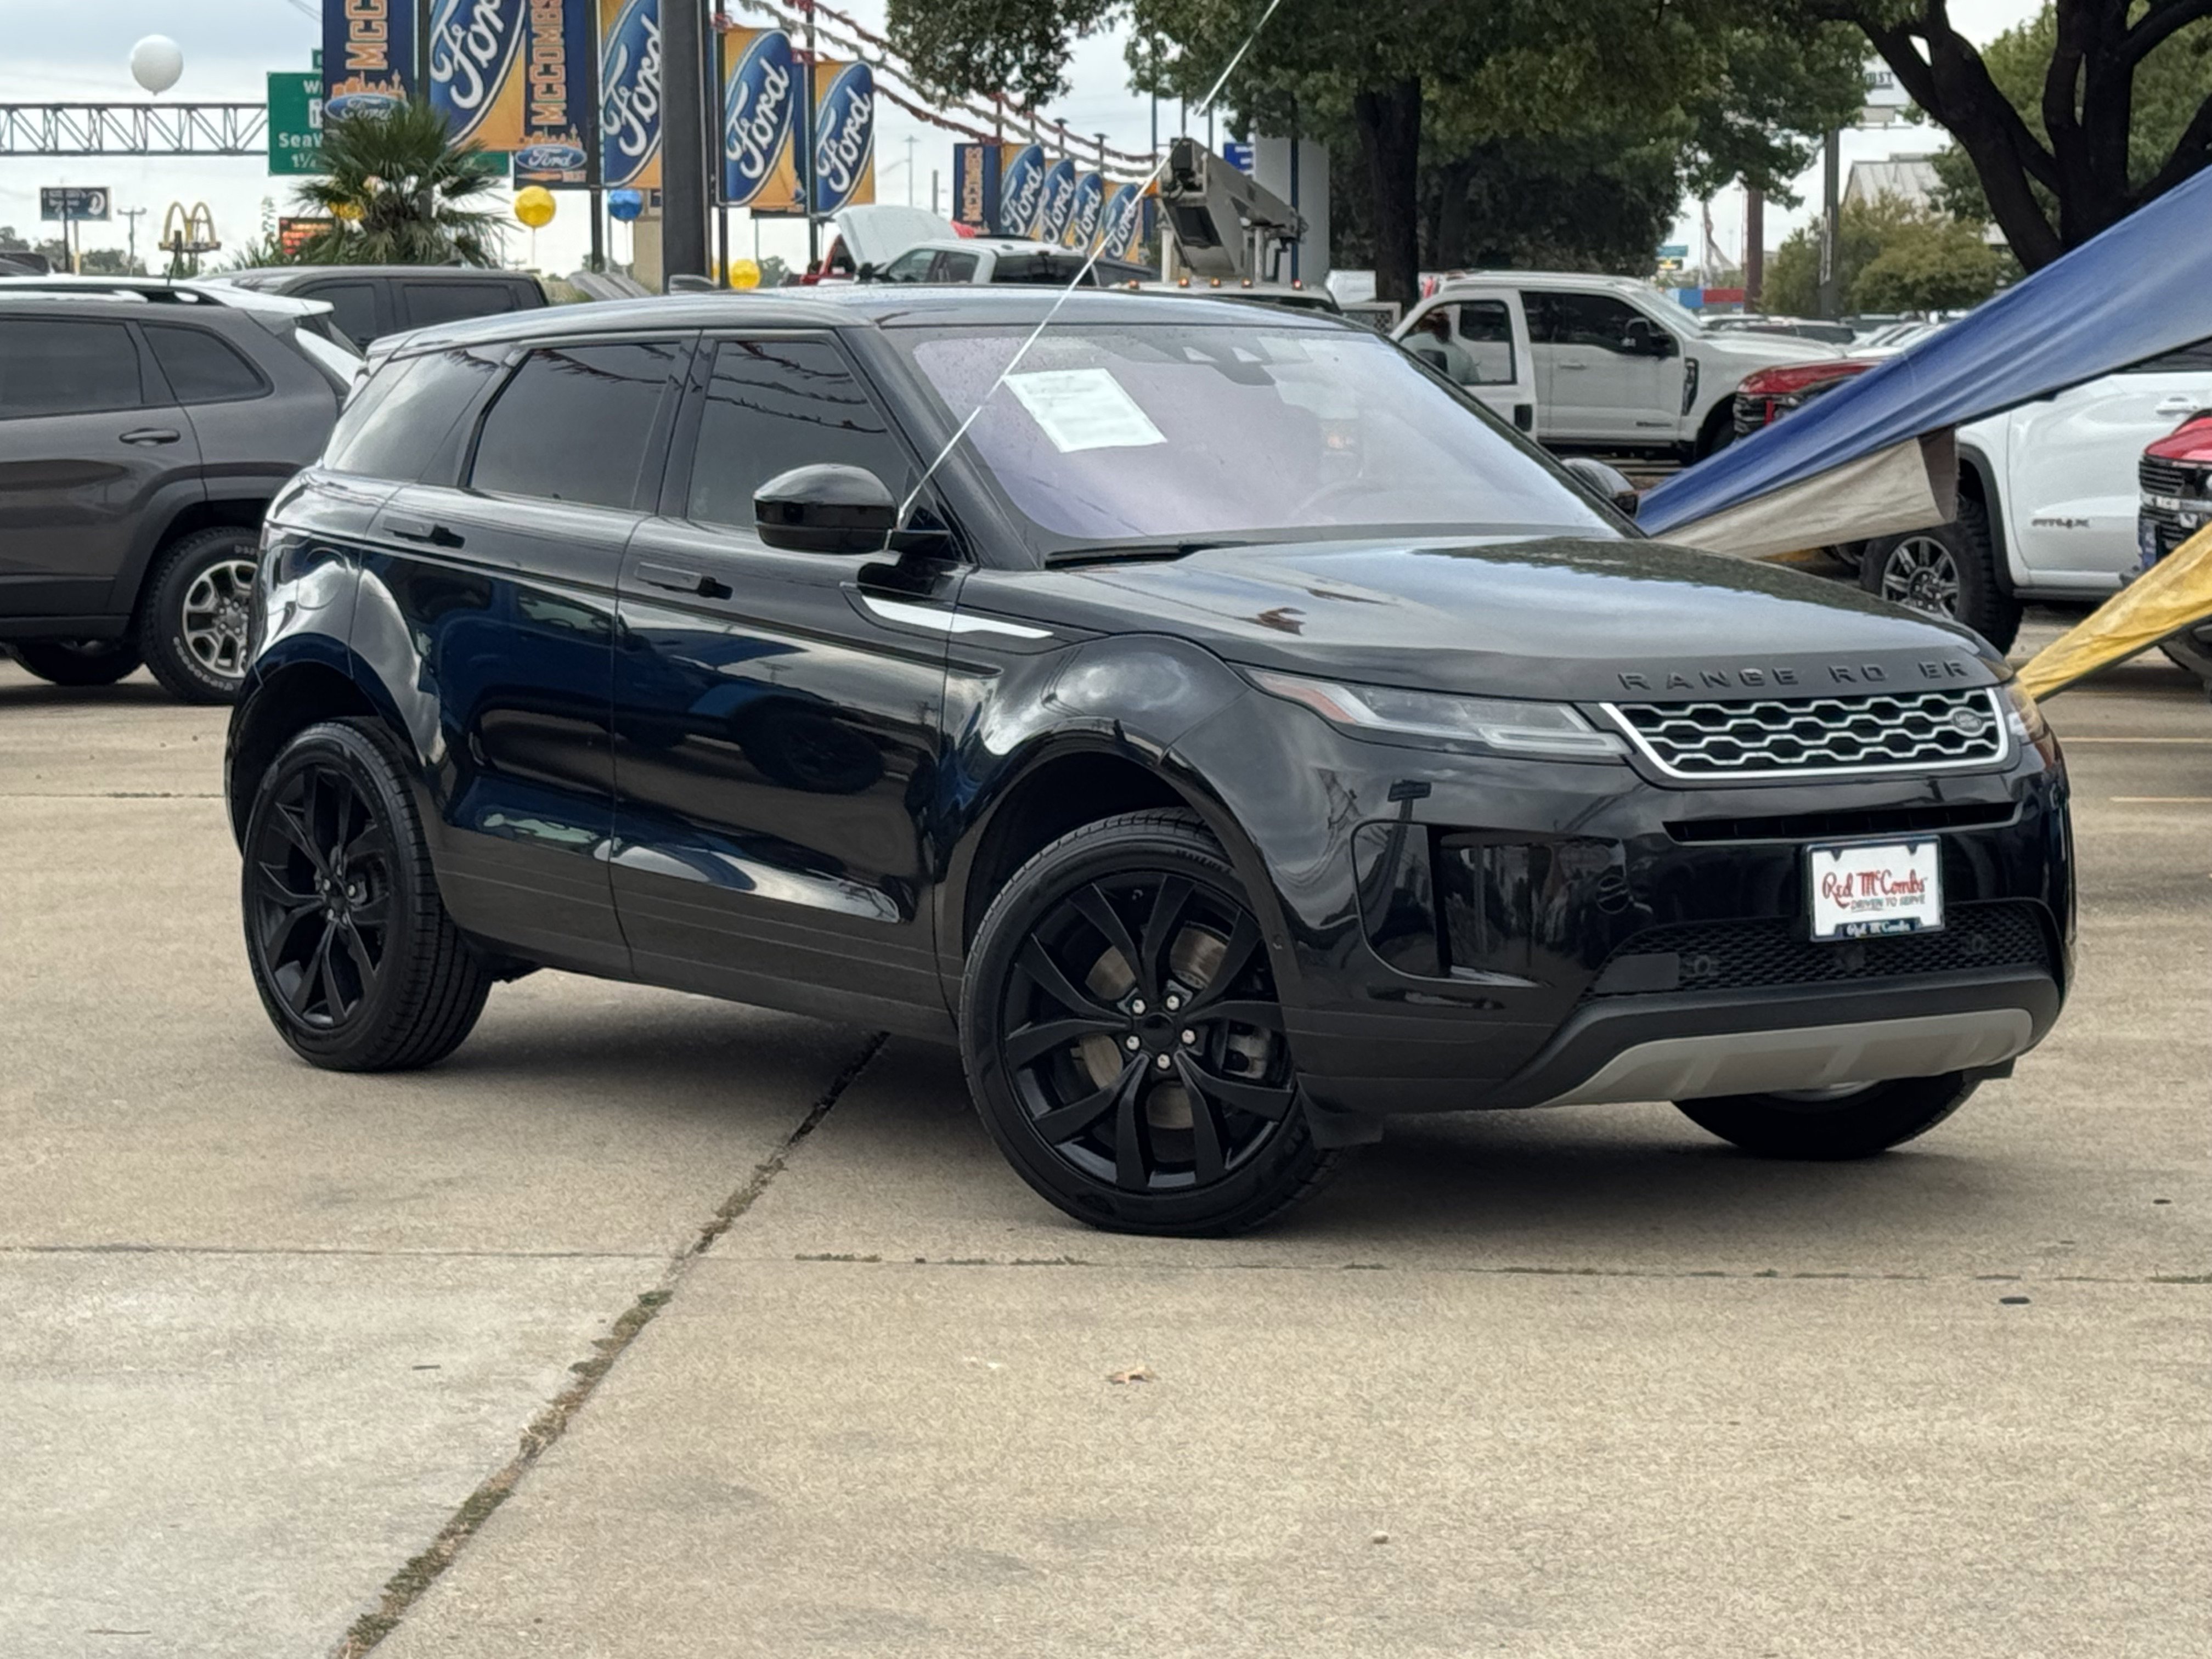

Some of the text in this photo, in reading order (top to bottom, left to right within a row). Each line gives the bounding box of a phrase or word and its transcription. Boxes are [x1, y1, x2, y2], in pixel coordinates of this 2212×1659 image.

[726, 57, 789, 178] Ford
[528, 148, 574, 166] Ford
[816, 86, 871, 192] Ford
[1000, 161, 1043, 235] Ford
[1618, 667, 1799, 691] RANGE
[1822, 869, 1926, 909] Red McCombs
[1851, 895, 1926, 910] DRIVEN TO SERVE
